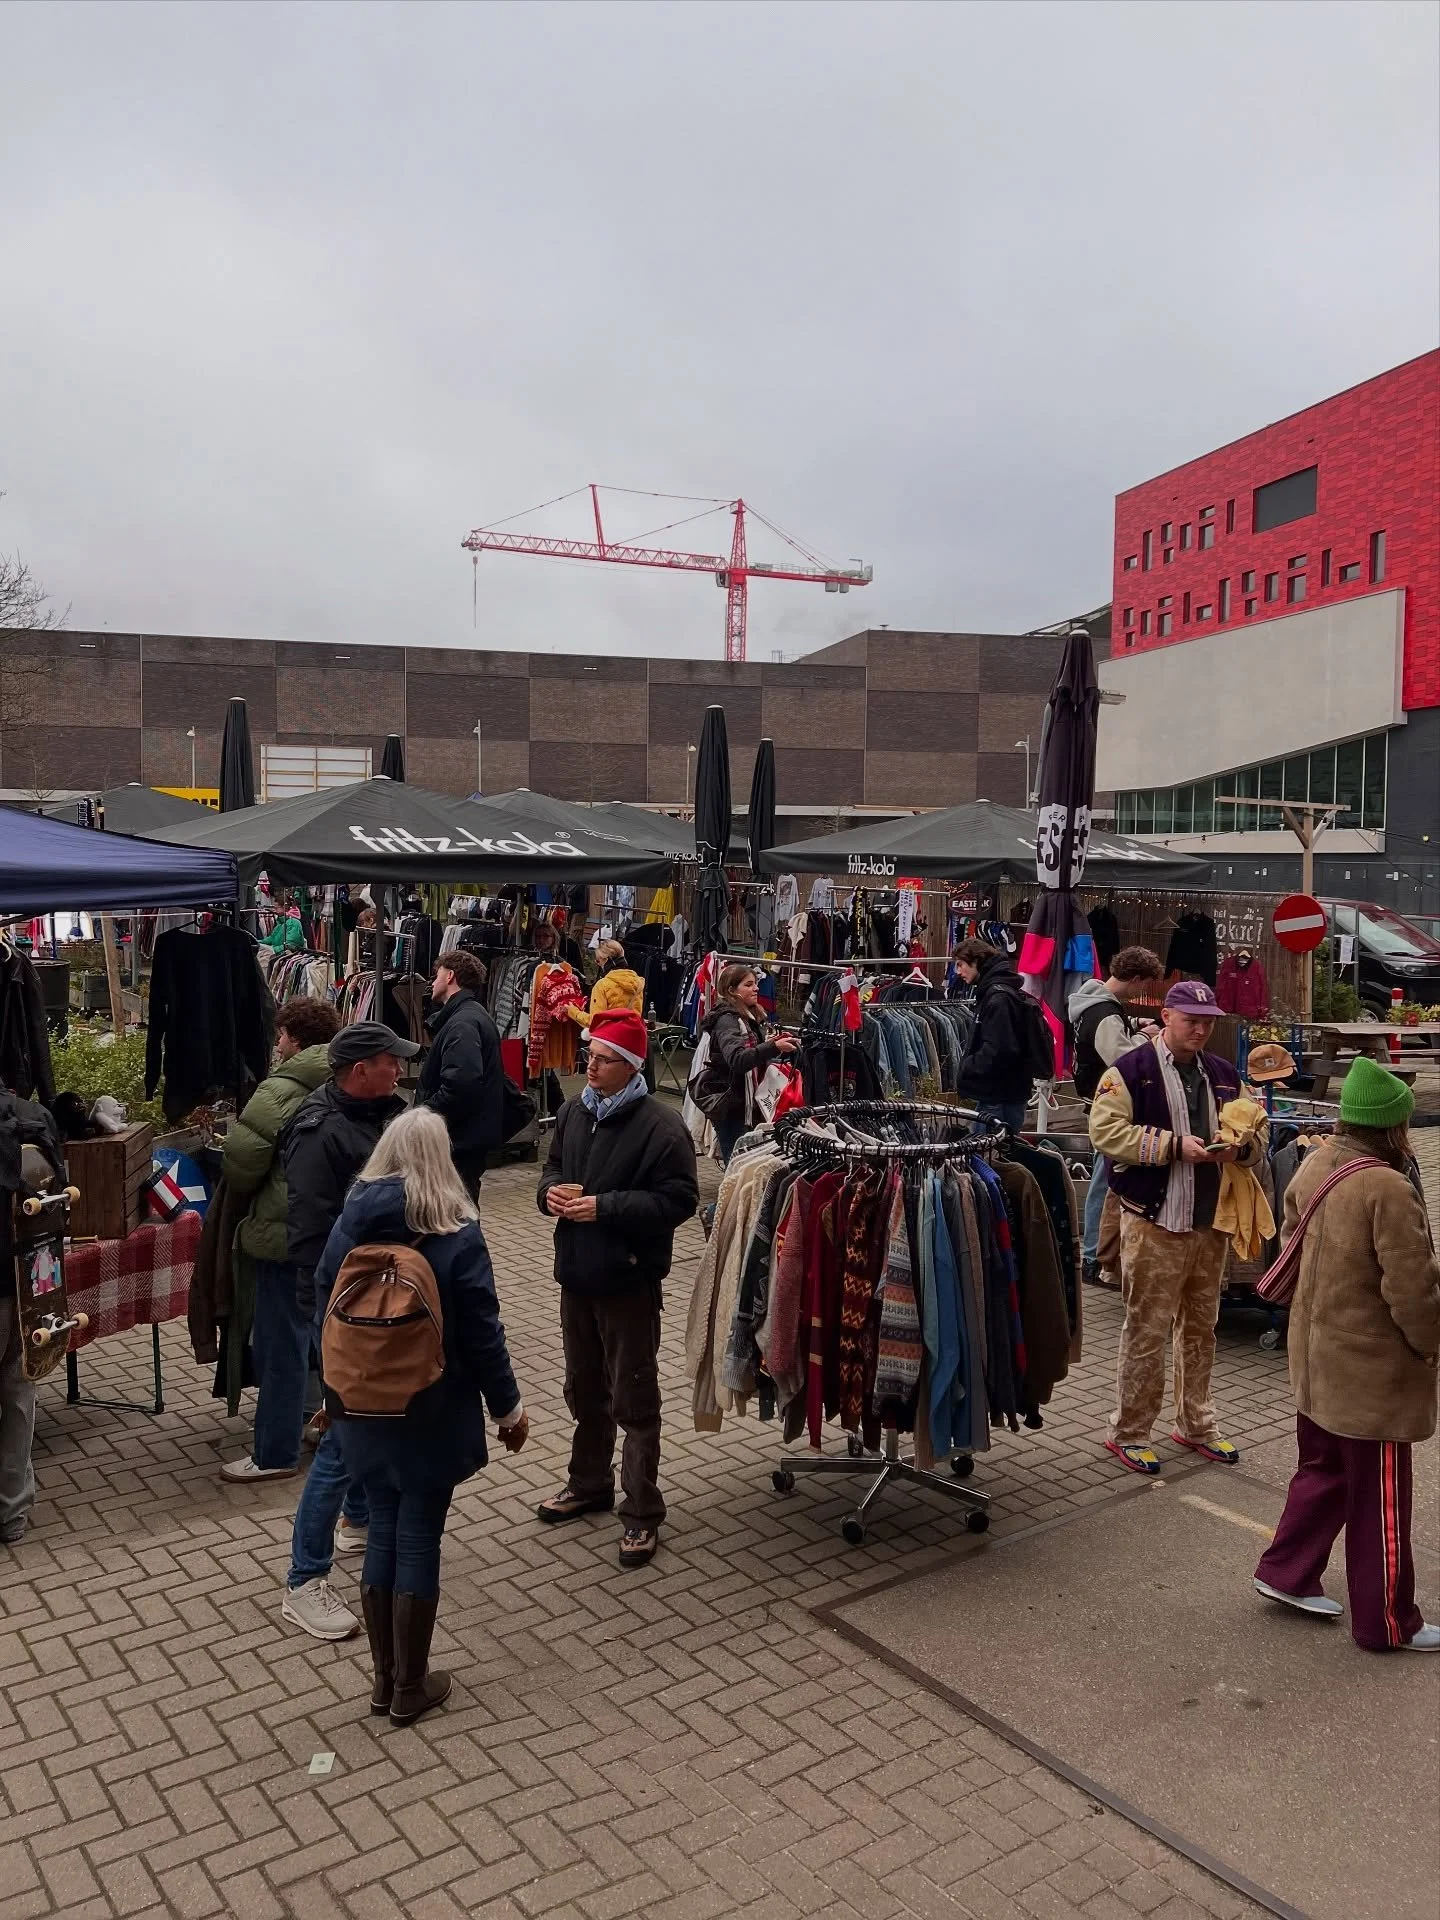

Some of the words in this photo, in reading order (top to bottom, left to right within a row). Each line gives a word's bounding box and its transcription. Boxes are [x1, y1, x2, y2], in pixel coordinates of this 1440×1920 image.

[349, 825, 588, 856] fritz-kola
[848, 854, 895, 876] fritz-kola
[1195, 988, 1209, 1002] R
